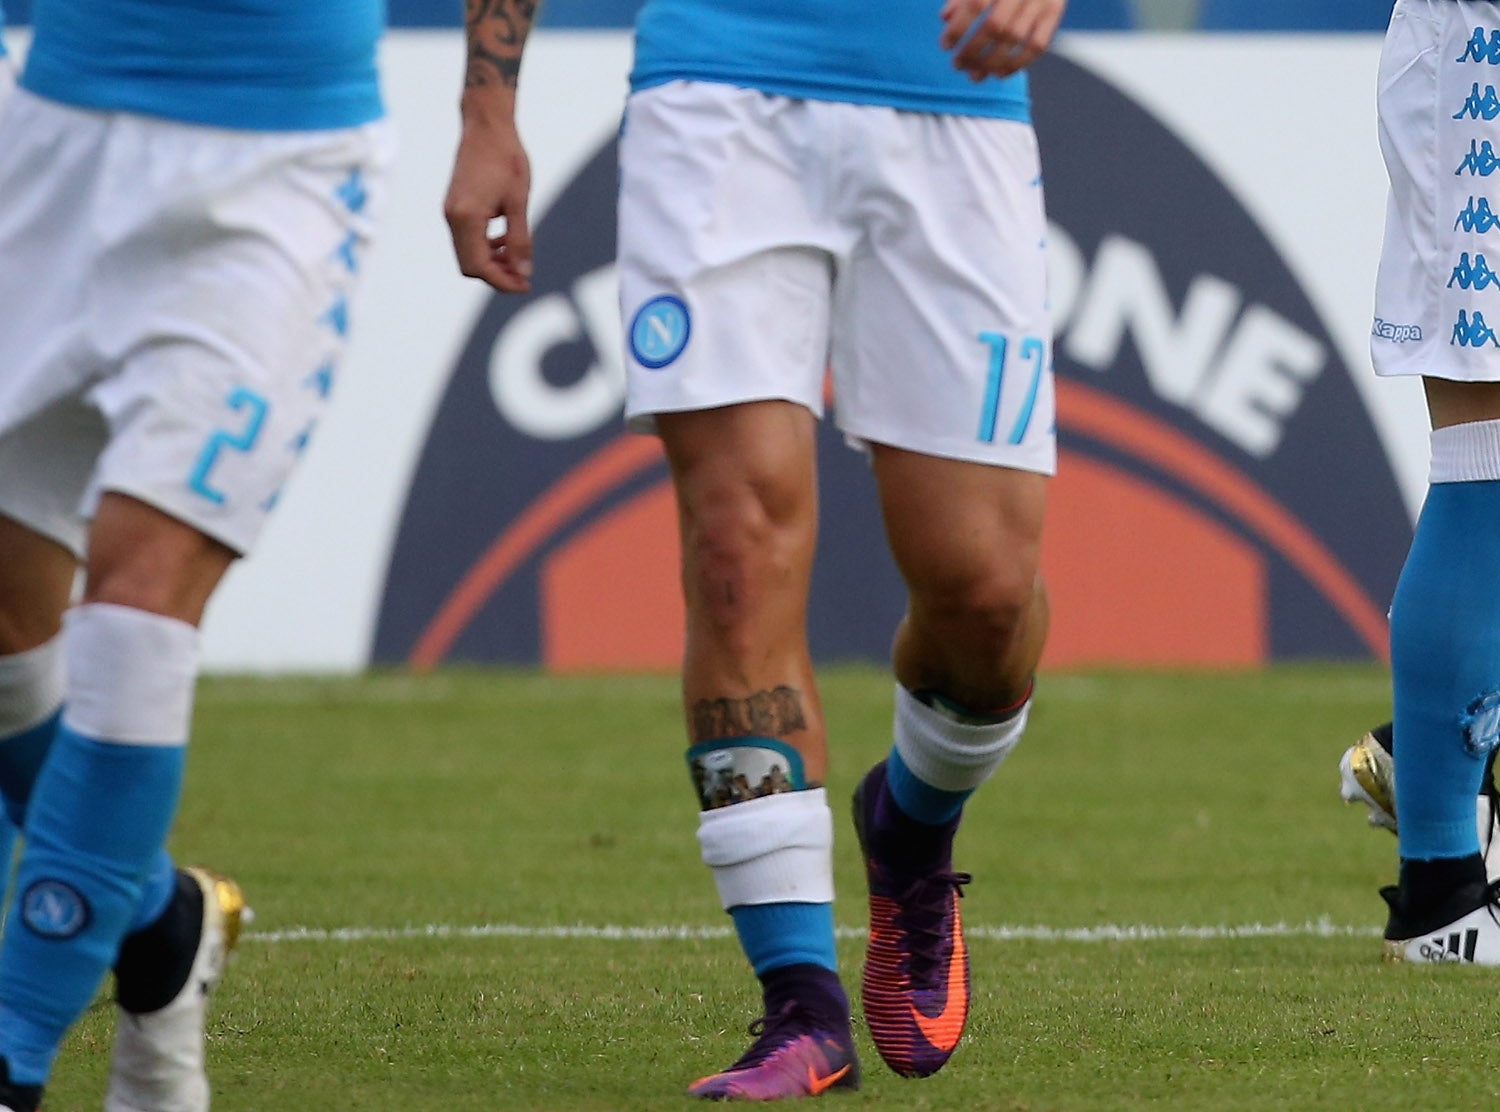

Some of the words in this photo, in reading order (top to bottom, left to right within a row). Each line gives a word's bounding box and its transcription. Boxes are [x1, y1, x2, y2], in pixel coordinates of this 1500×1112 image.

[645, 312, 674, 349] N
[1372, 317, 1423, 343] Kappa
[977, 331, 1044, 446] 17
[188, 383, 270, 507] 2
